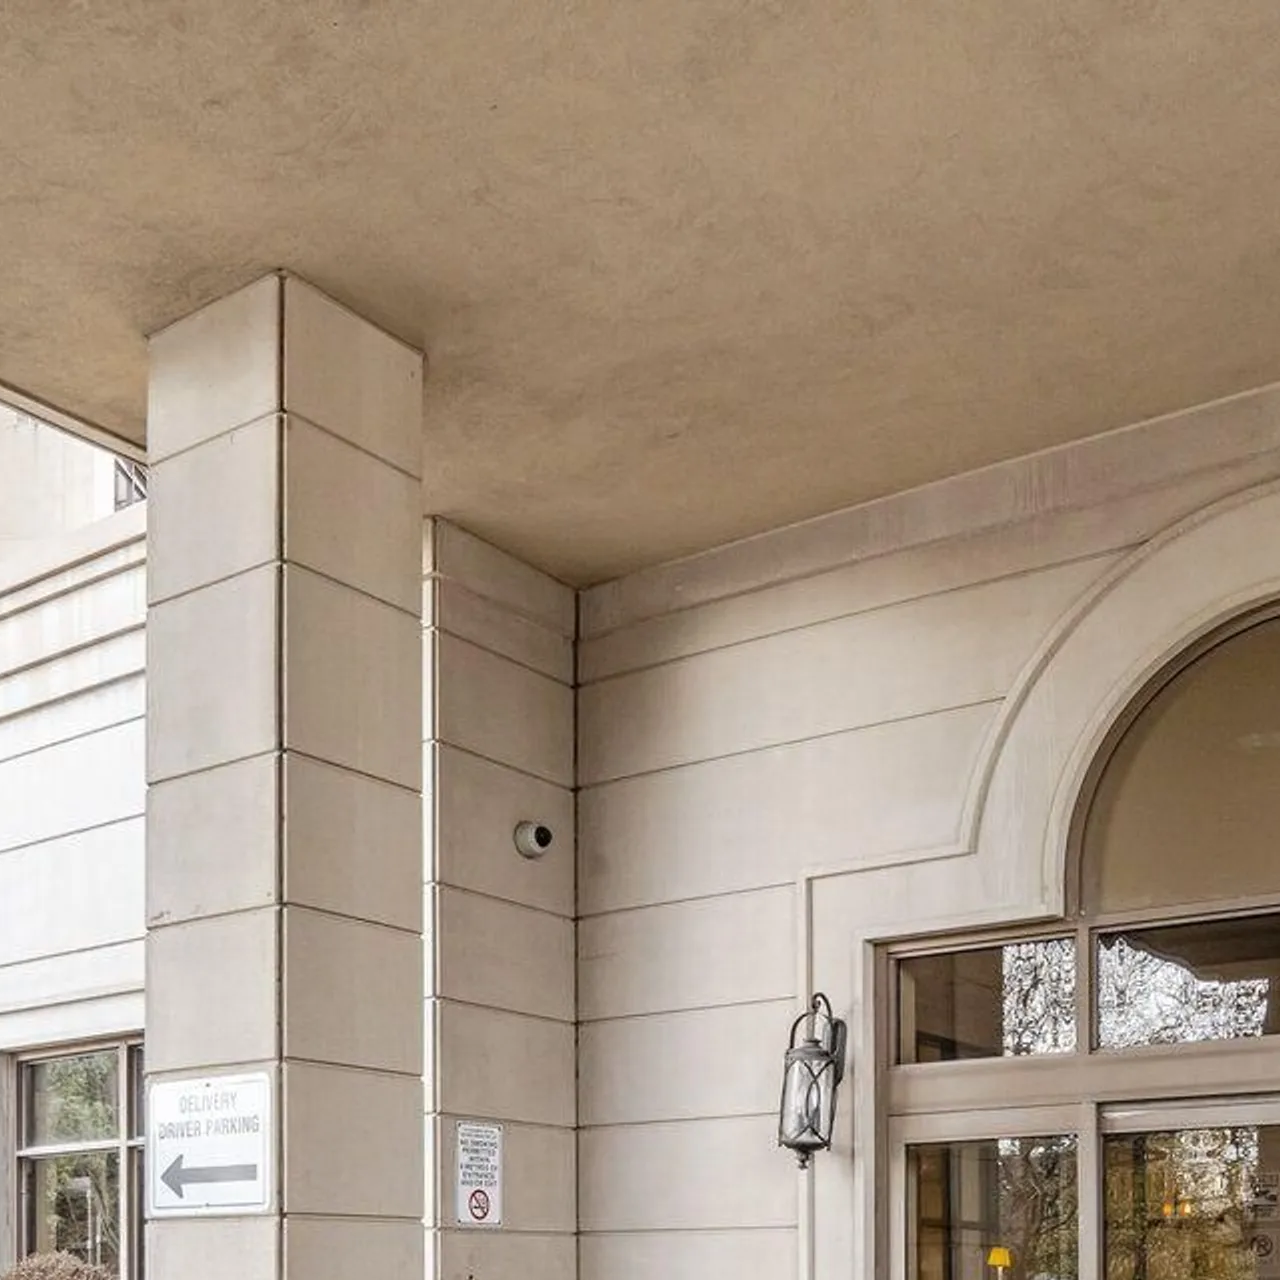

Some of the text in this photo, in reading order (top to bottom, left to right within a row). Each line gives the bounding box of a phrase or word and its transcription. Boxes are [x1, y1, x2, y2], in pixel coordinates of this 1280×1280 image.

[179, 1092, 238, 1113] DELIVERY
[158, 1115, 260, 1140] DRIVER PARKING
